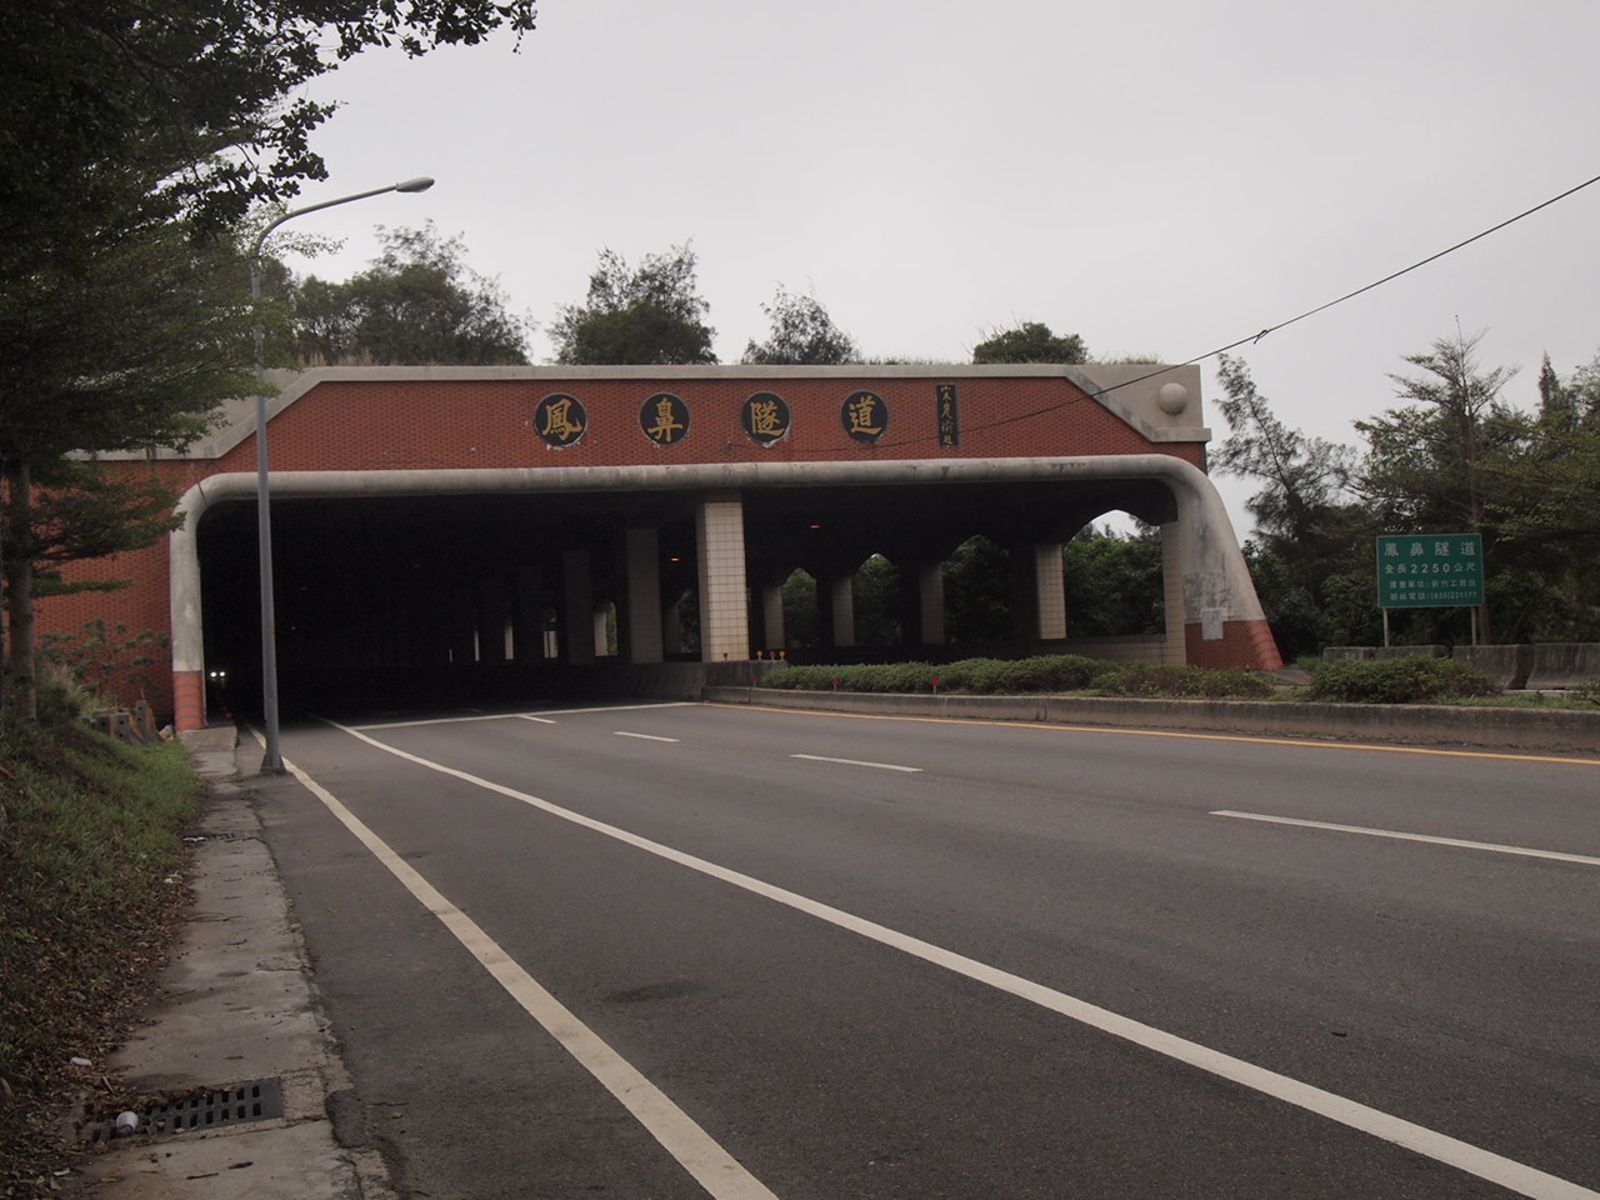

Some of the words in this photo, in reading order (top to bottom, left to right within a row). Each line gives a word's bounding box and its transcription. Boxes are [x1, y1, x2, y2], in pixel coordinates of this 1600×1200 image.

[542, 397, 882, 441] 鳳鼻隧道
[1384, 541, 1476, 557] 鳳鼻隧道
[1384, 562, 1476, 574] 全長2250公尺
